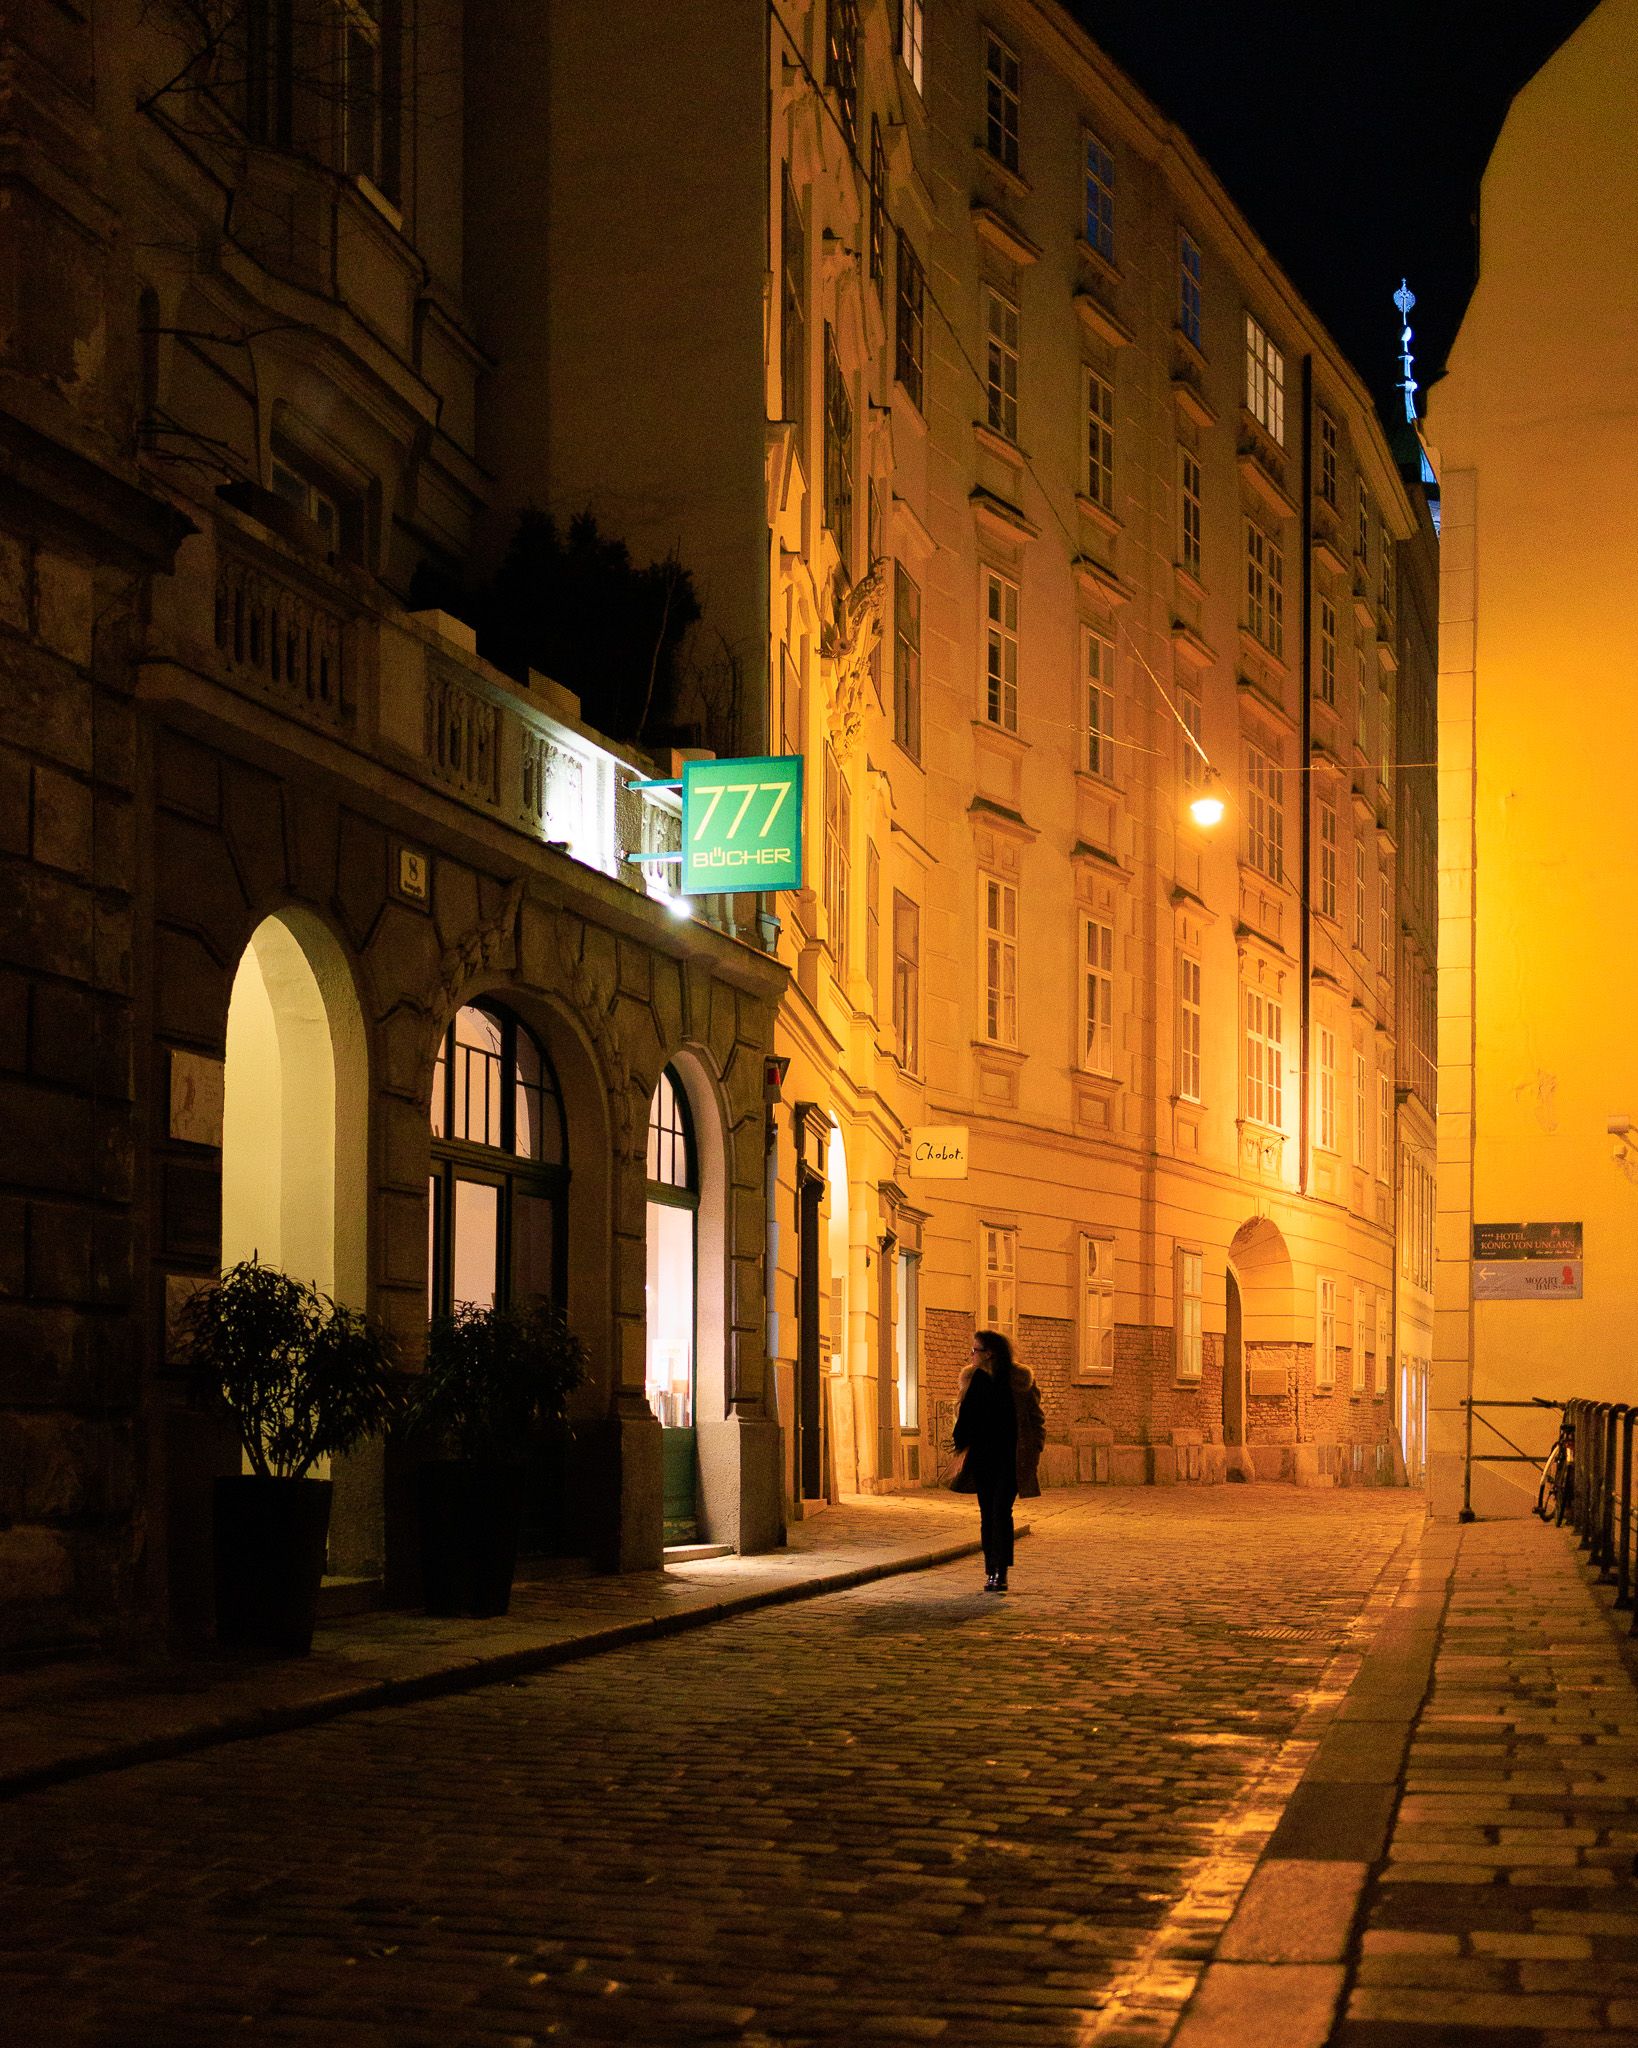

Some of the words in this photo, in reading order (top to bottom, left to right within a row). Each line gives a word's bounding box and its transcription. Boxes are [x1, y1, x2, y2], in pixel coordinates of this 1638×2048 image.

[693, 781, 792, 841] 777
[692, 846, 792, 868] BÜCHER
[1495, 1232, 1526, 1241] HOTEL
[1513, 1240, 1534, 1249] VON
[1535, 1240, 1575, 1249] UNGARN
[1525, 1276, 1558, 1284] MOZART
